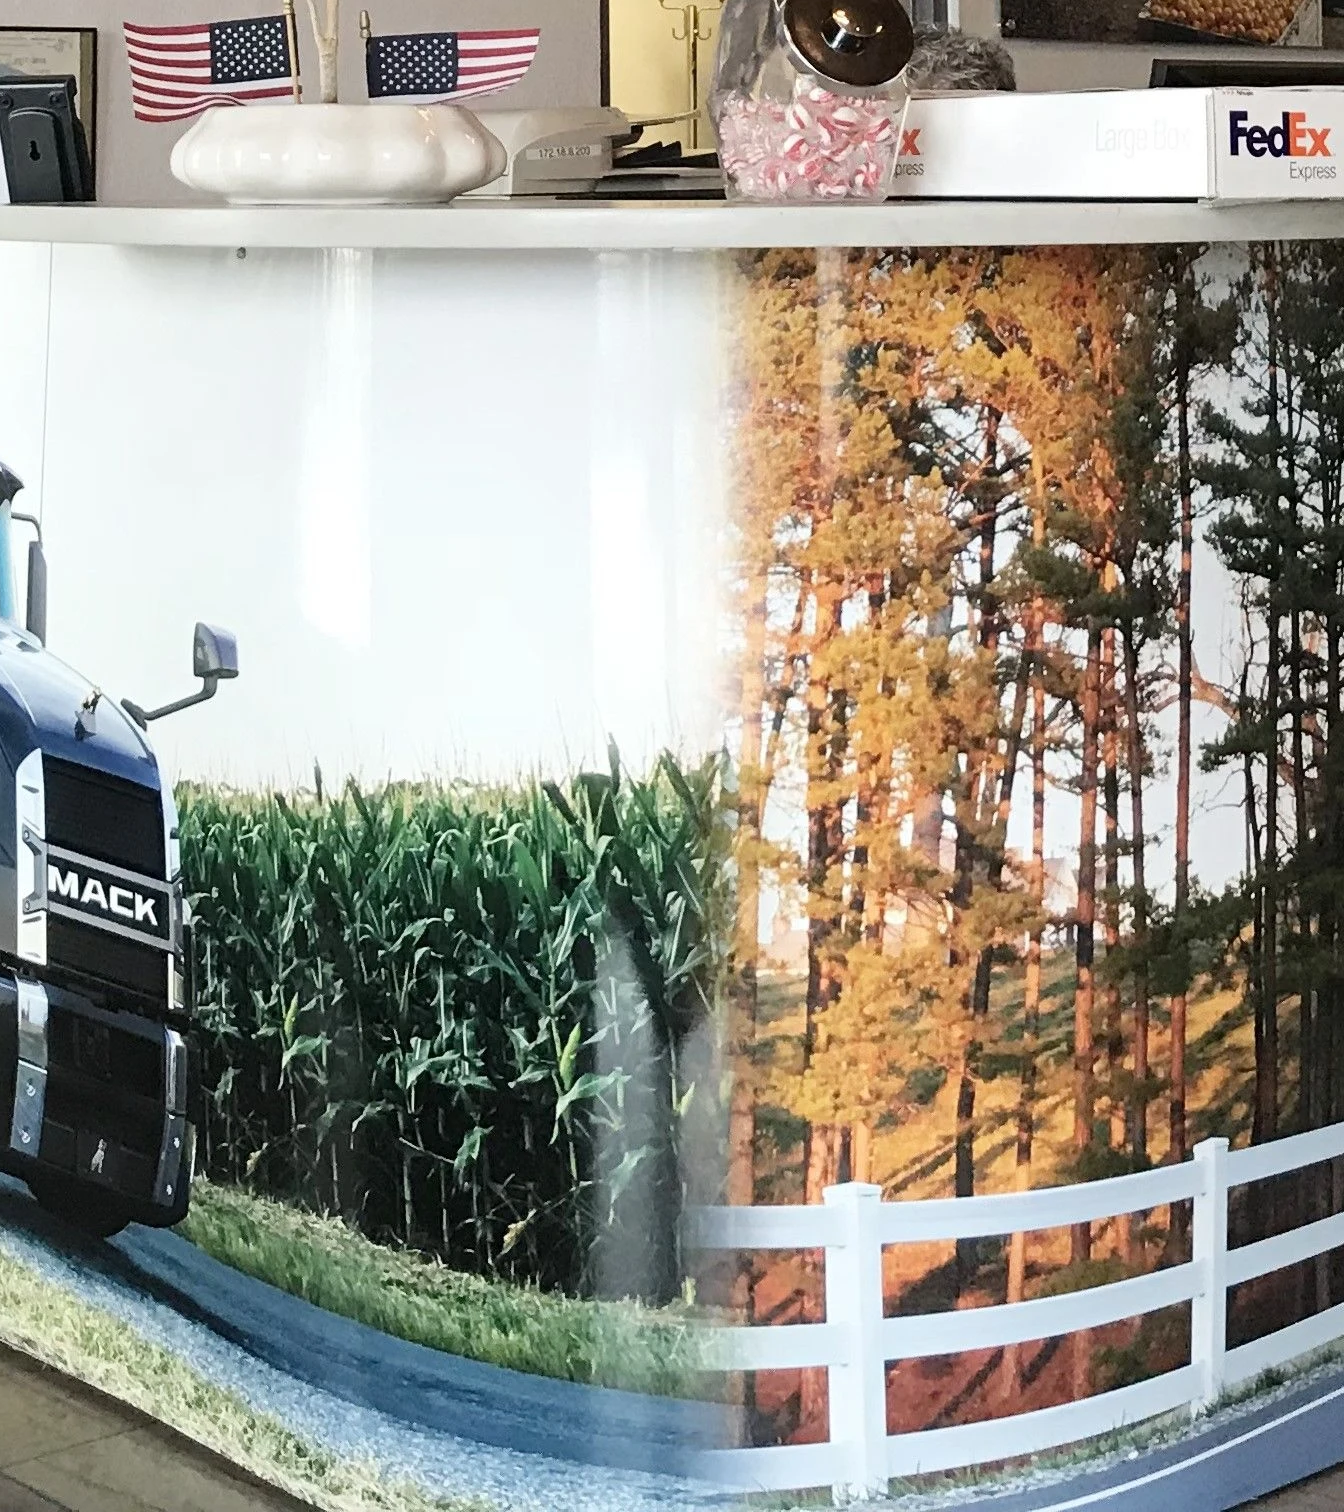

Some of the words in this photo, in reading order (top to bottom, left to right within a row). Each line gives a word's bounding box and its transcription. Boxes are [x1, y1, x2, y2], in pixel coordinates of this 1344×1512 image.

[1094, 118, 1148, 159] Large
[1229, 110, 1333, 158] FedEx
[894, 162, 925, 179] press
[1289, 161, 1337, 182] Express
[47, 863, 159, 926] MACK
